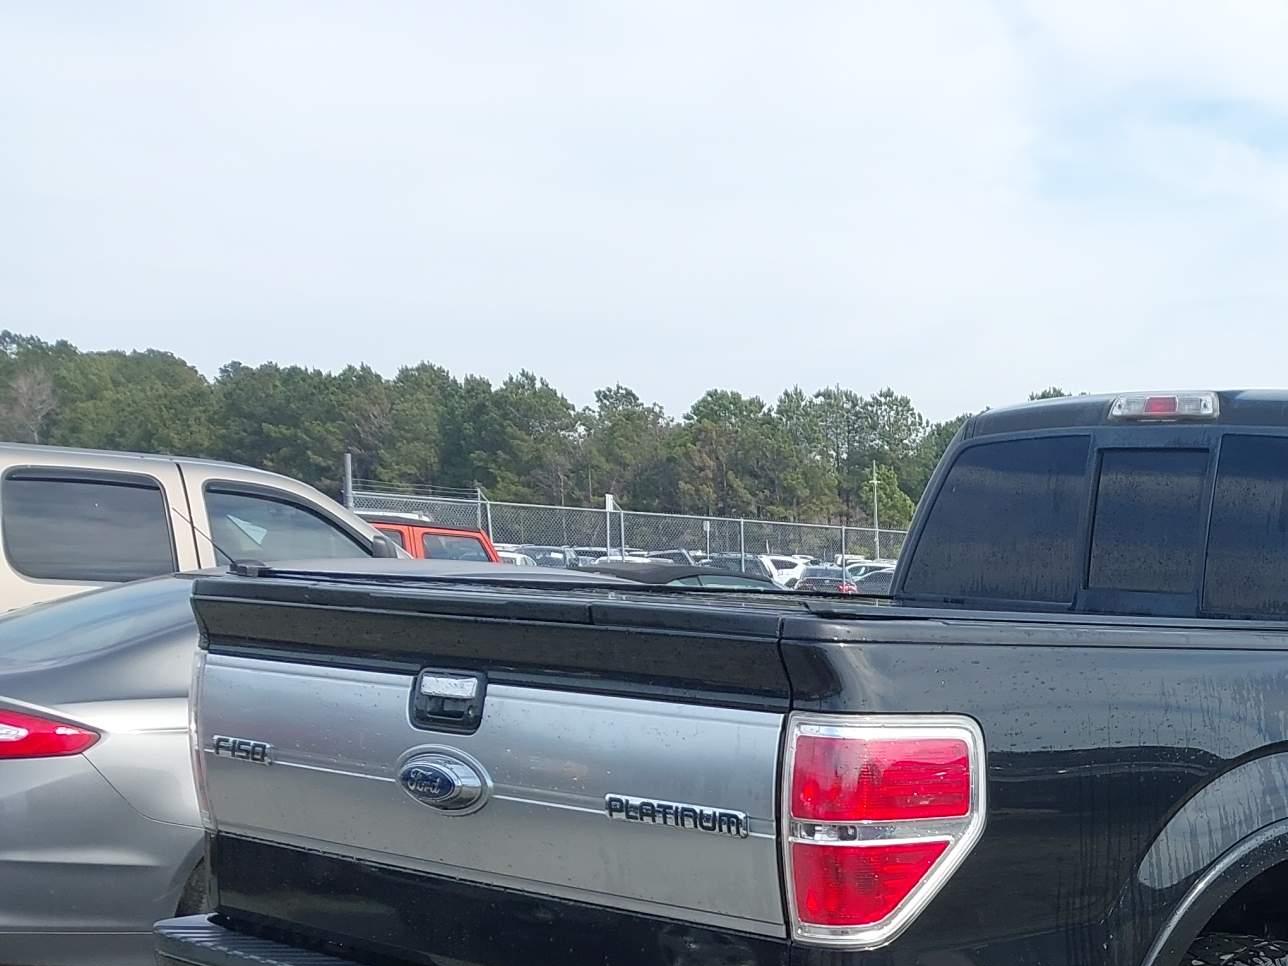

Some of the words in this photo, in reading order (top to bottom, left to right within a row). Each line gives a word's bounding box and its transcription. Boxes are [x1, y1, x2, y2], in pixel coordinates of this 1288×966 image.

[215, 737, 267, 763] F150
[407, 767, 442, 794] Ford
[607, 796, 744, 836] PLATINUM
